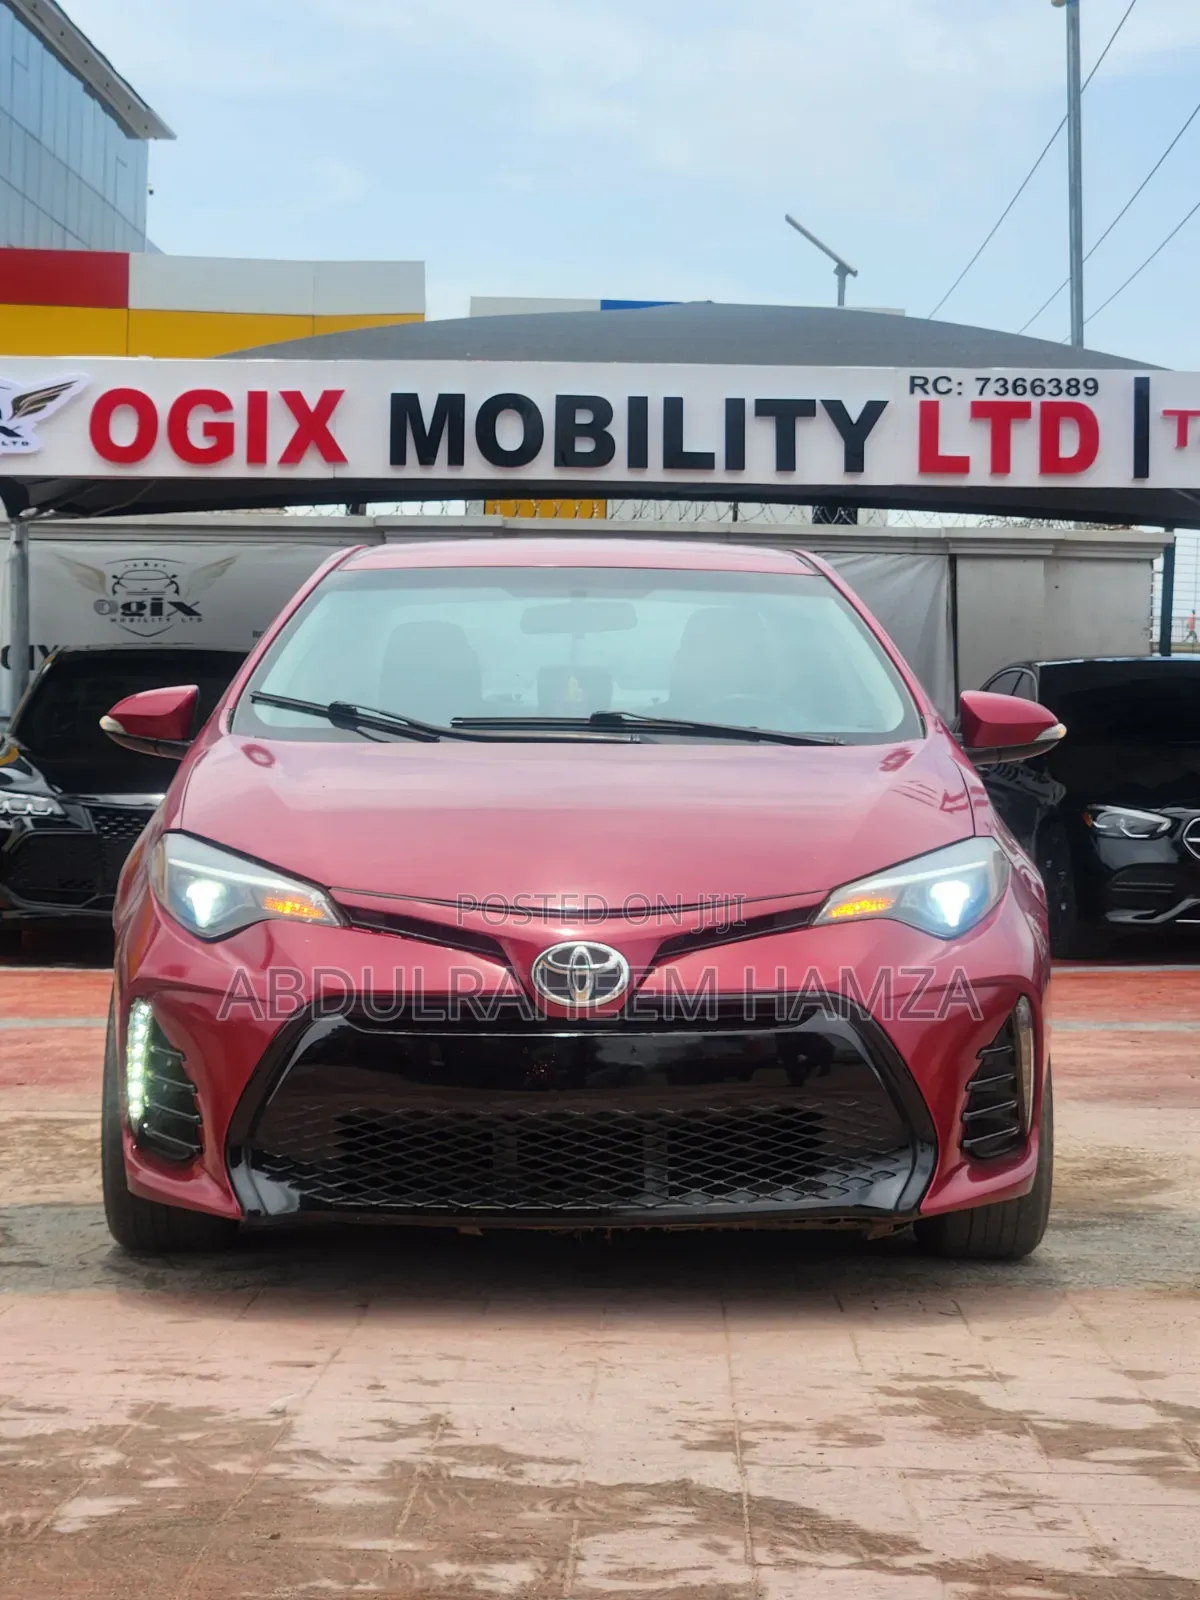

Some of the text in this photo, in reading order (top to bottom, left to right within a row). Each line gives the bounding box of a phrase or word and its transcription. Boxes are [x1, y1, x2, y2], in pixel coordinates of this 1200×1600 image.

[909, 375, 1099, 396] RC: 7366389
[89, 388, 348, 465] OGIX
[389, 392, 889, 473] MOBILITY
[918, 400, 1100, 475] LTD
